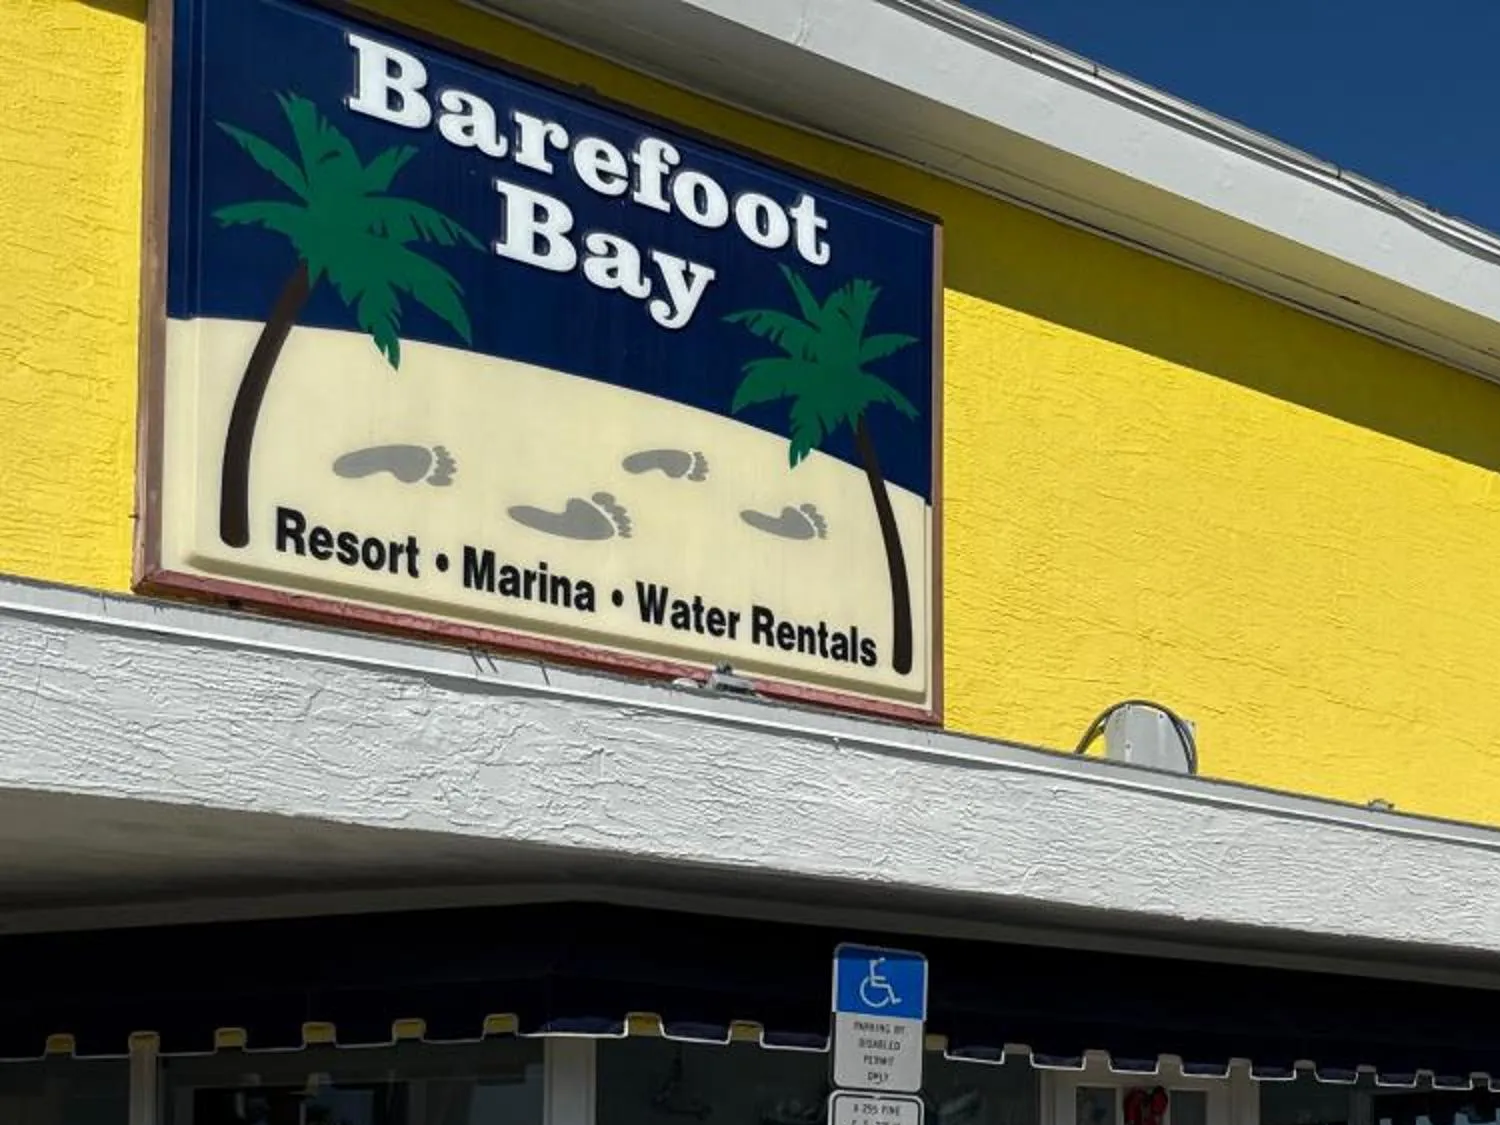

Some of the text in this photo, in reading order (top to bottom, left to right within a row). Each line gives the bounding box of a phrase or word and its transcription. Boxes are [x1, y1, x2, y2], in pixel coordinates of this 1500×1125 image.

[344, 32, 832, 266] Barefoot
[494, 180, 716, 330] Bay
[275, 506, 878, 668] Resort Marina Water Rentals
[854, 1021, 891, 1034] PARKING
[858, 1038, 900, 1051] DISABLED
[864, 1055, 895, 1066] PERMIT
[868, 1072, 889, 1082] ONLY
[881, 1104, 900, 1116] FINE
